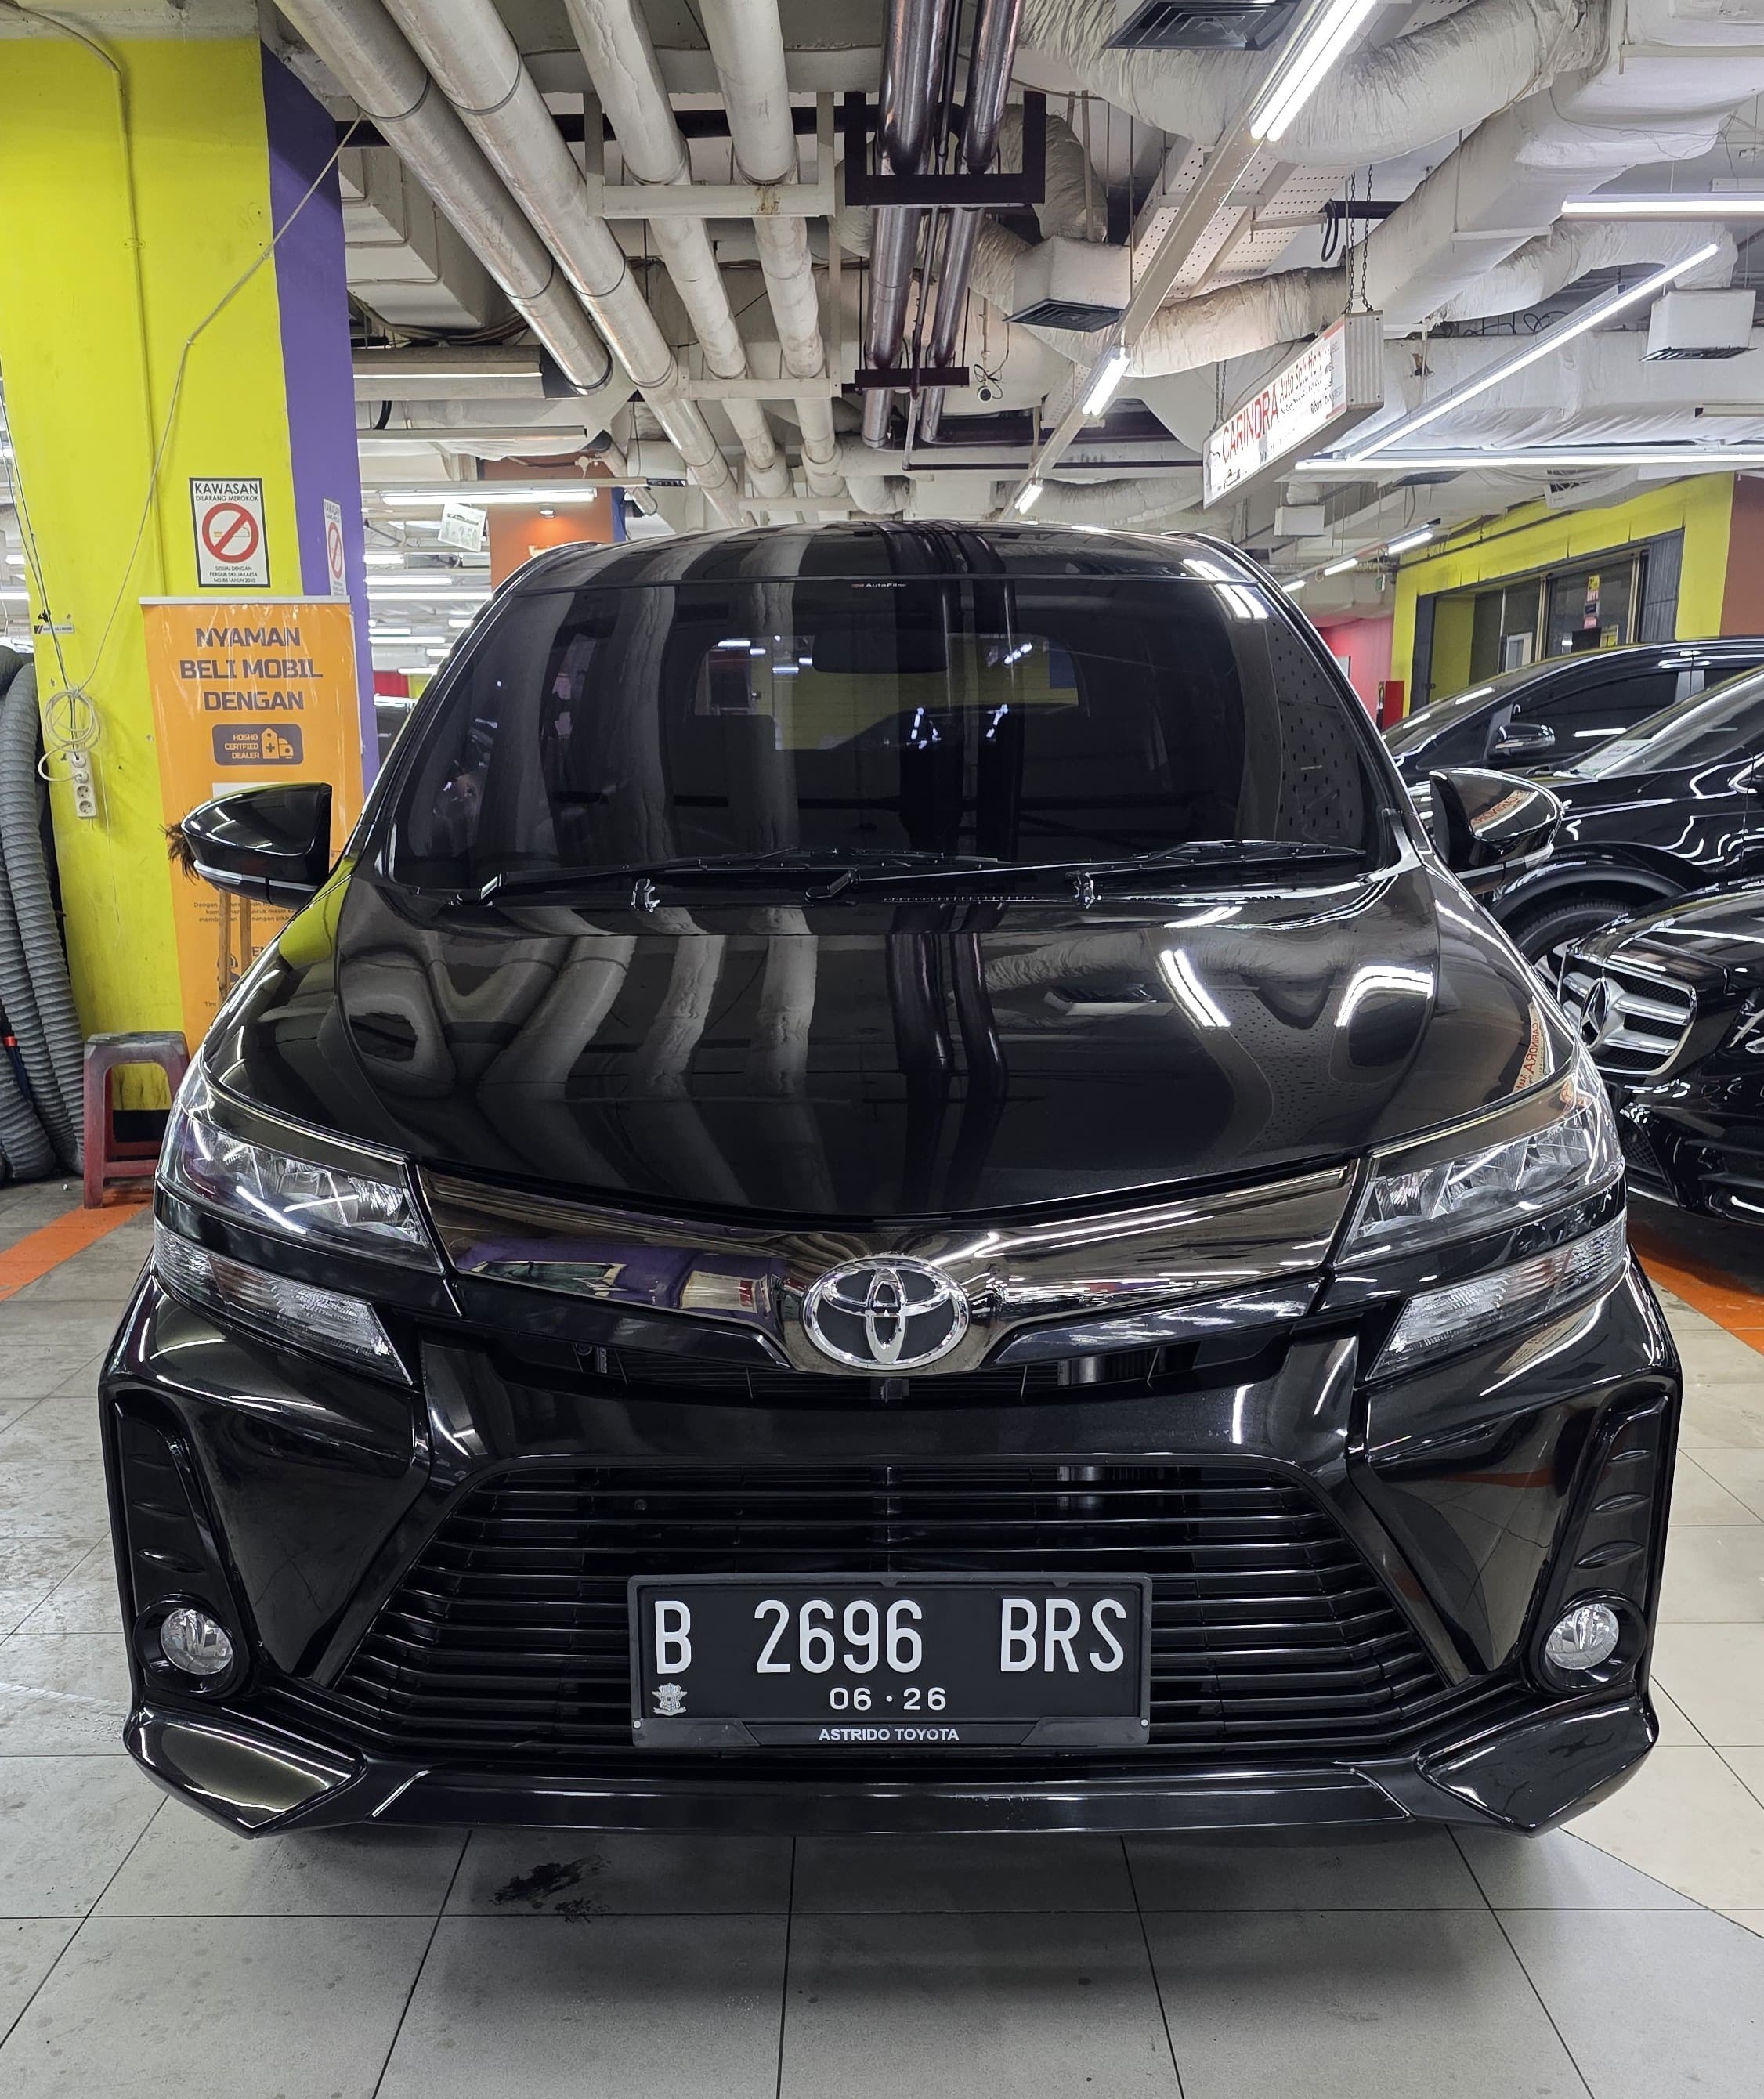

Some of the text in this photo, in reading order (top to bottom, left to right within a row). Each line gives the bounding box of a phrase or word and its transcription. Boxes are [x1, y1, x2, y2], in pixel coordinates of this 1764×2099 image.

[1223, 384, 1279, 464] CARINDRA
[1279, 374, 1293, 403] Auto
[1295, 349, 1321, 390] Solution
[195, 483, 258, 494] KAWASAN
[196, 627, 300, 647] NYAMAN
[179, 659, 323, 679] BELI MOBIL
[204, 691, 304, 710] DENGAN
[654, 1598, 1127, 1675] B 2696 BRS
[829, 1686, 873, 1711] 06
[902, 1686, 947, 1711] 26
[818, 1728, 960, 1741] ASTRIDO TOYOTA
